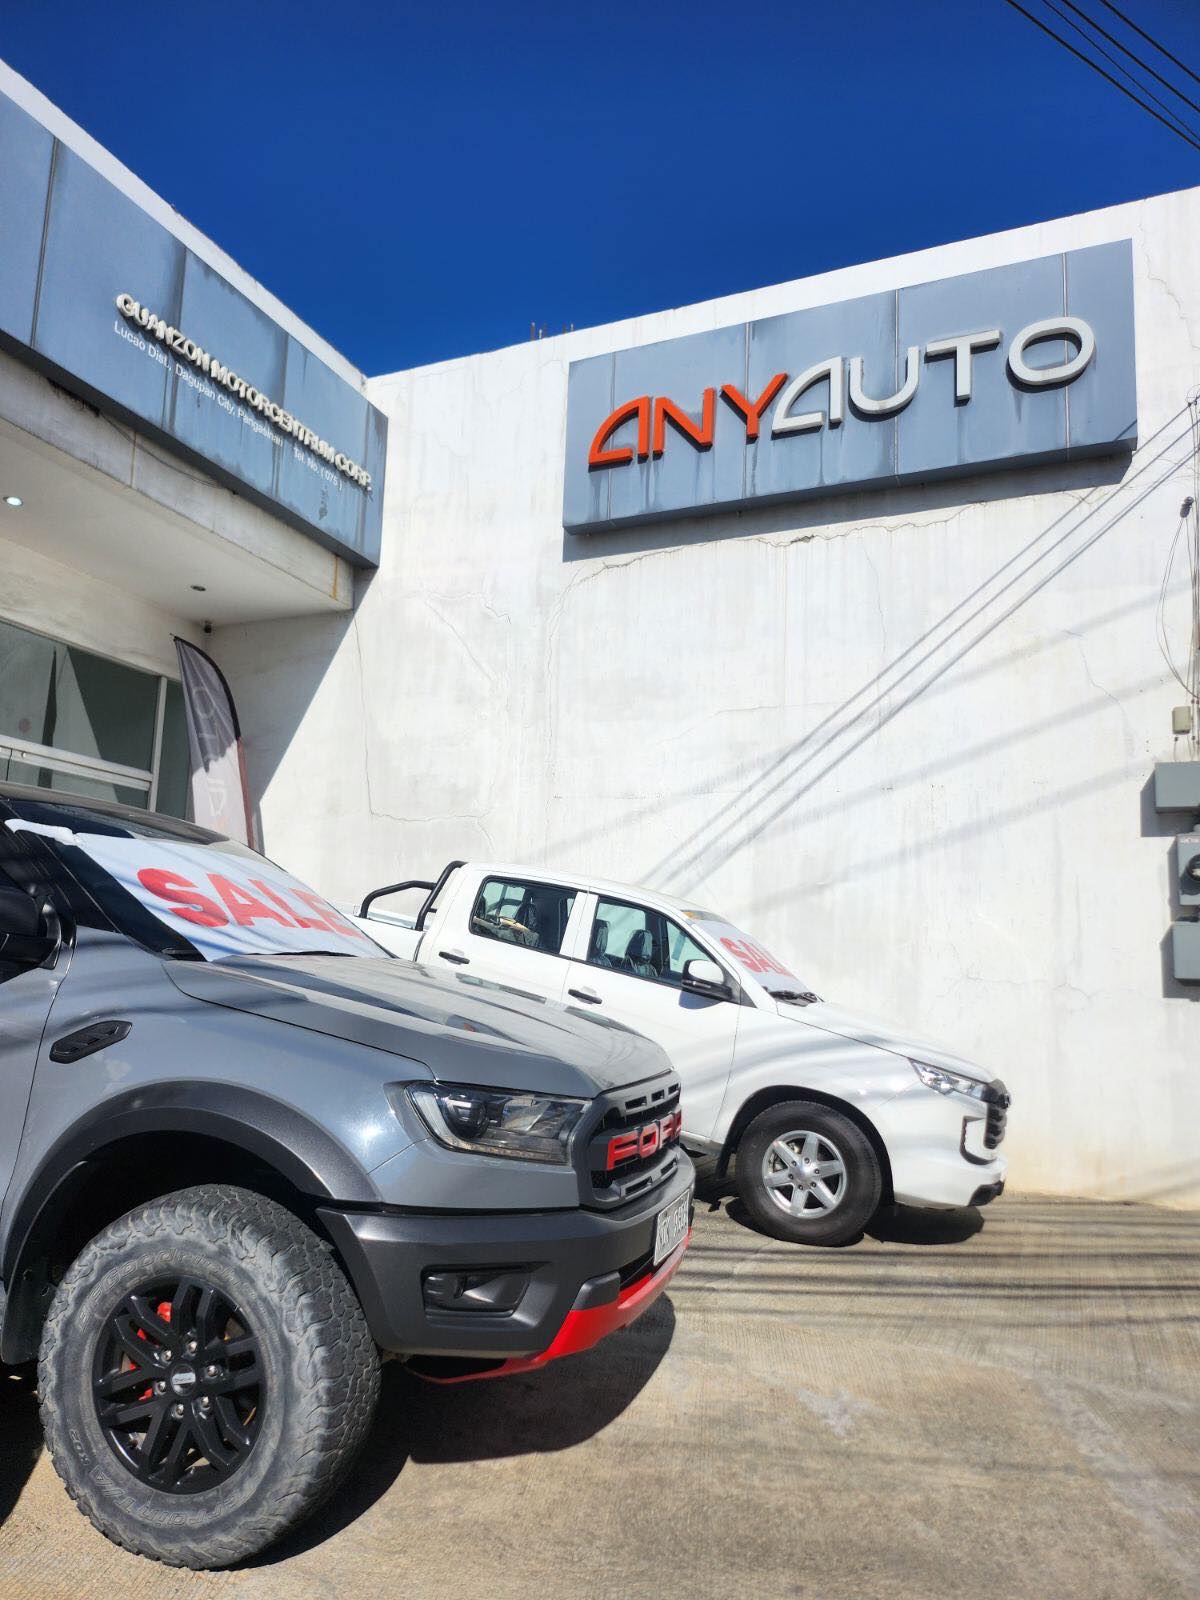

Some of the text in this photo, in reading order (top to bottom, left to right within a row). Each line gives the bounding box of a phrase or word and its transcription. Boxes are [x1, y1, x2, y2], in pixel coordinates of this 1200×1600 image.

[114, 320, 146, 352] Lucao
[175, 363, 216, 401] Dagupan
[116, 293, 211, 373] GUANZON
[137, 868, 369, 941] SALE
